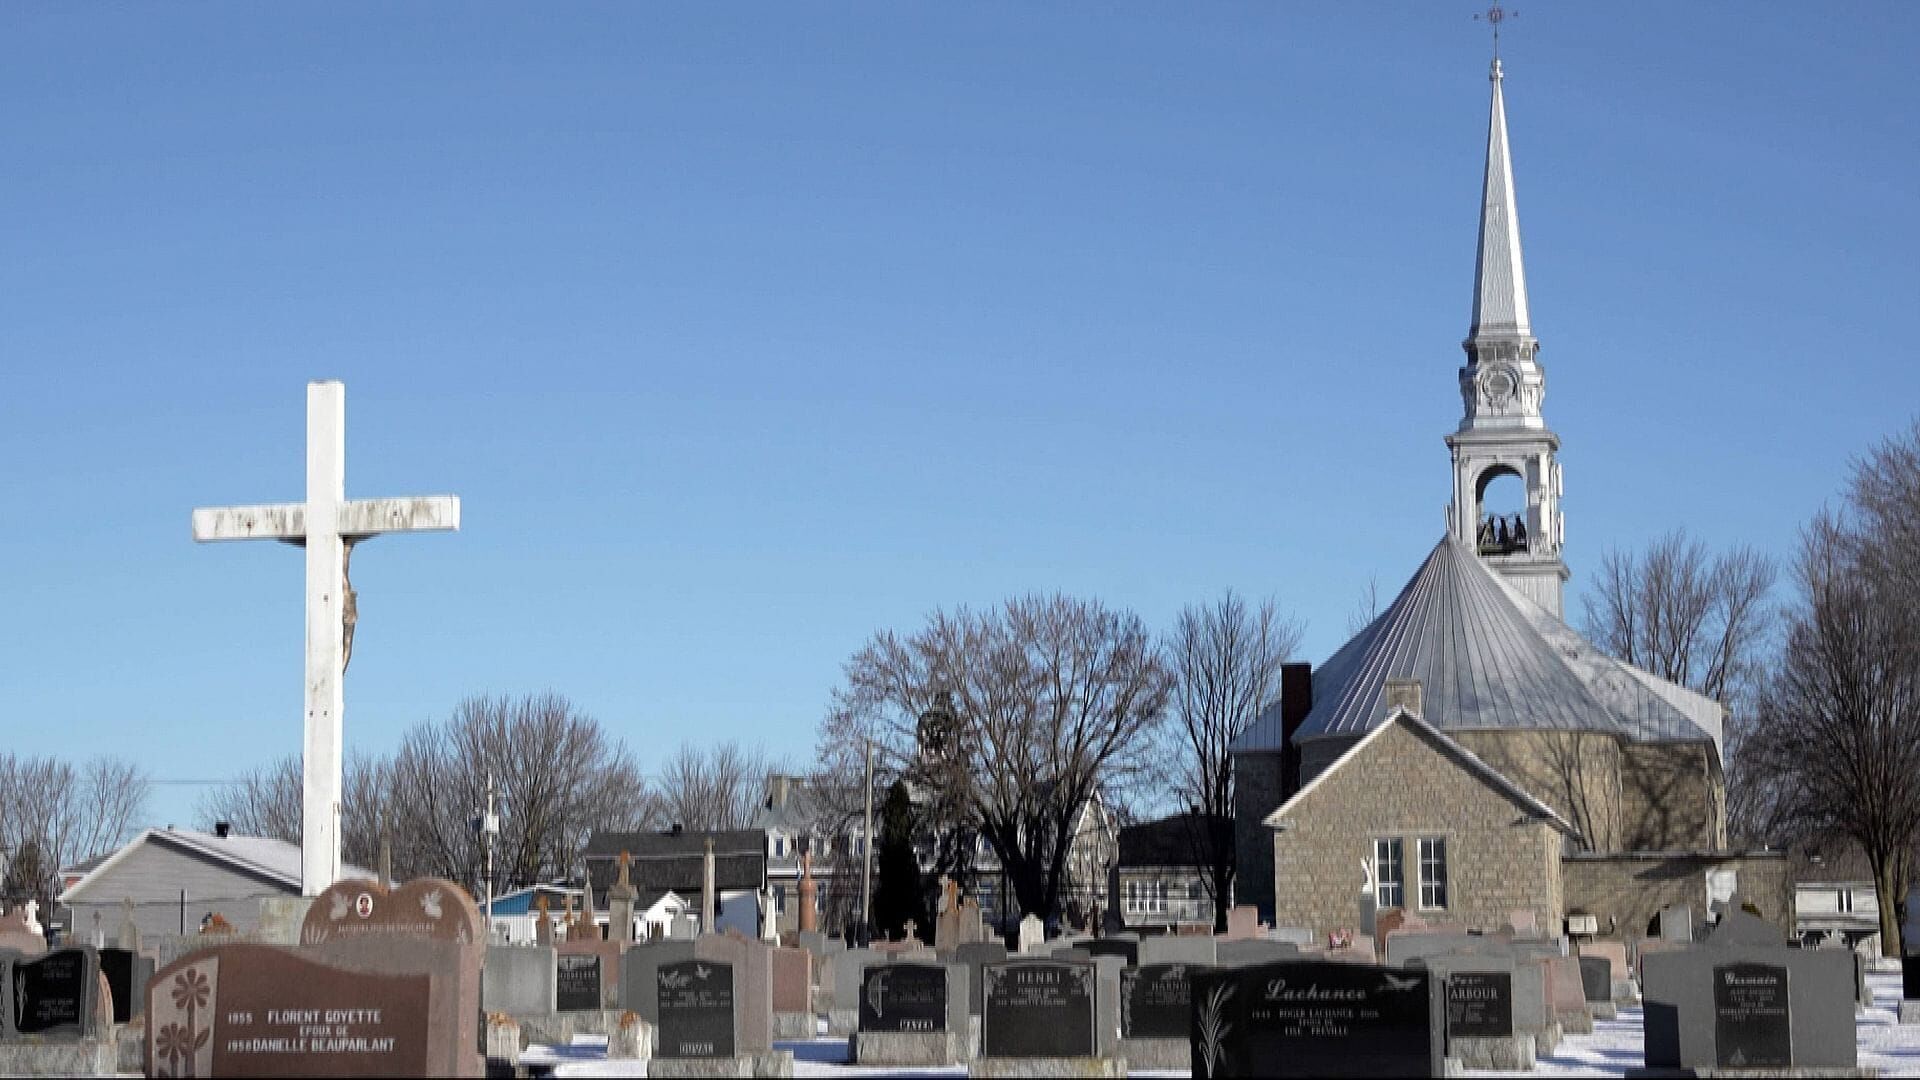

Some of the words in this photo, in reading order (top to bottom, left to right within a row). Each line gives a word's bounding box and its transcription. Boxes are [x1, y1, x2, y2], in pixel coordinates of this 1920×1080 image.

[1017, 971, 1060, 984] HENRI
[1264, 979, 1366, 1000] Lachance
[1450, 988, 1497, 999] ARBOUR
[267, 1009, 320, 1024] FLORENT
[325, 1009, 382, 1024] GOYETTE
[1309, 1008, 1354, 1019] LACHANCE
[335, 1025, 349, 1037] DE
[251, 1038, 308, 1052] DANIELLE
[311, 1038, 396, 1052] BEAUPARLANT
